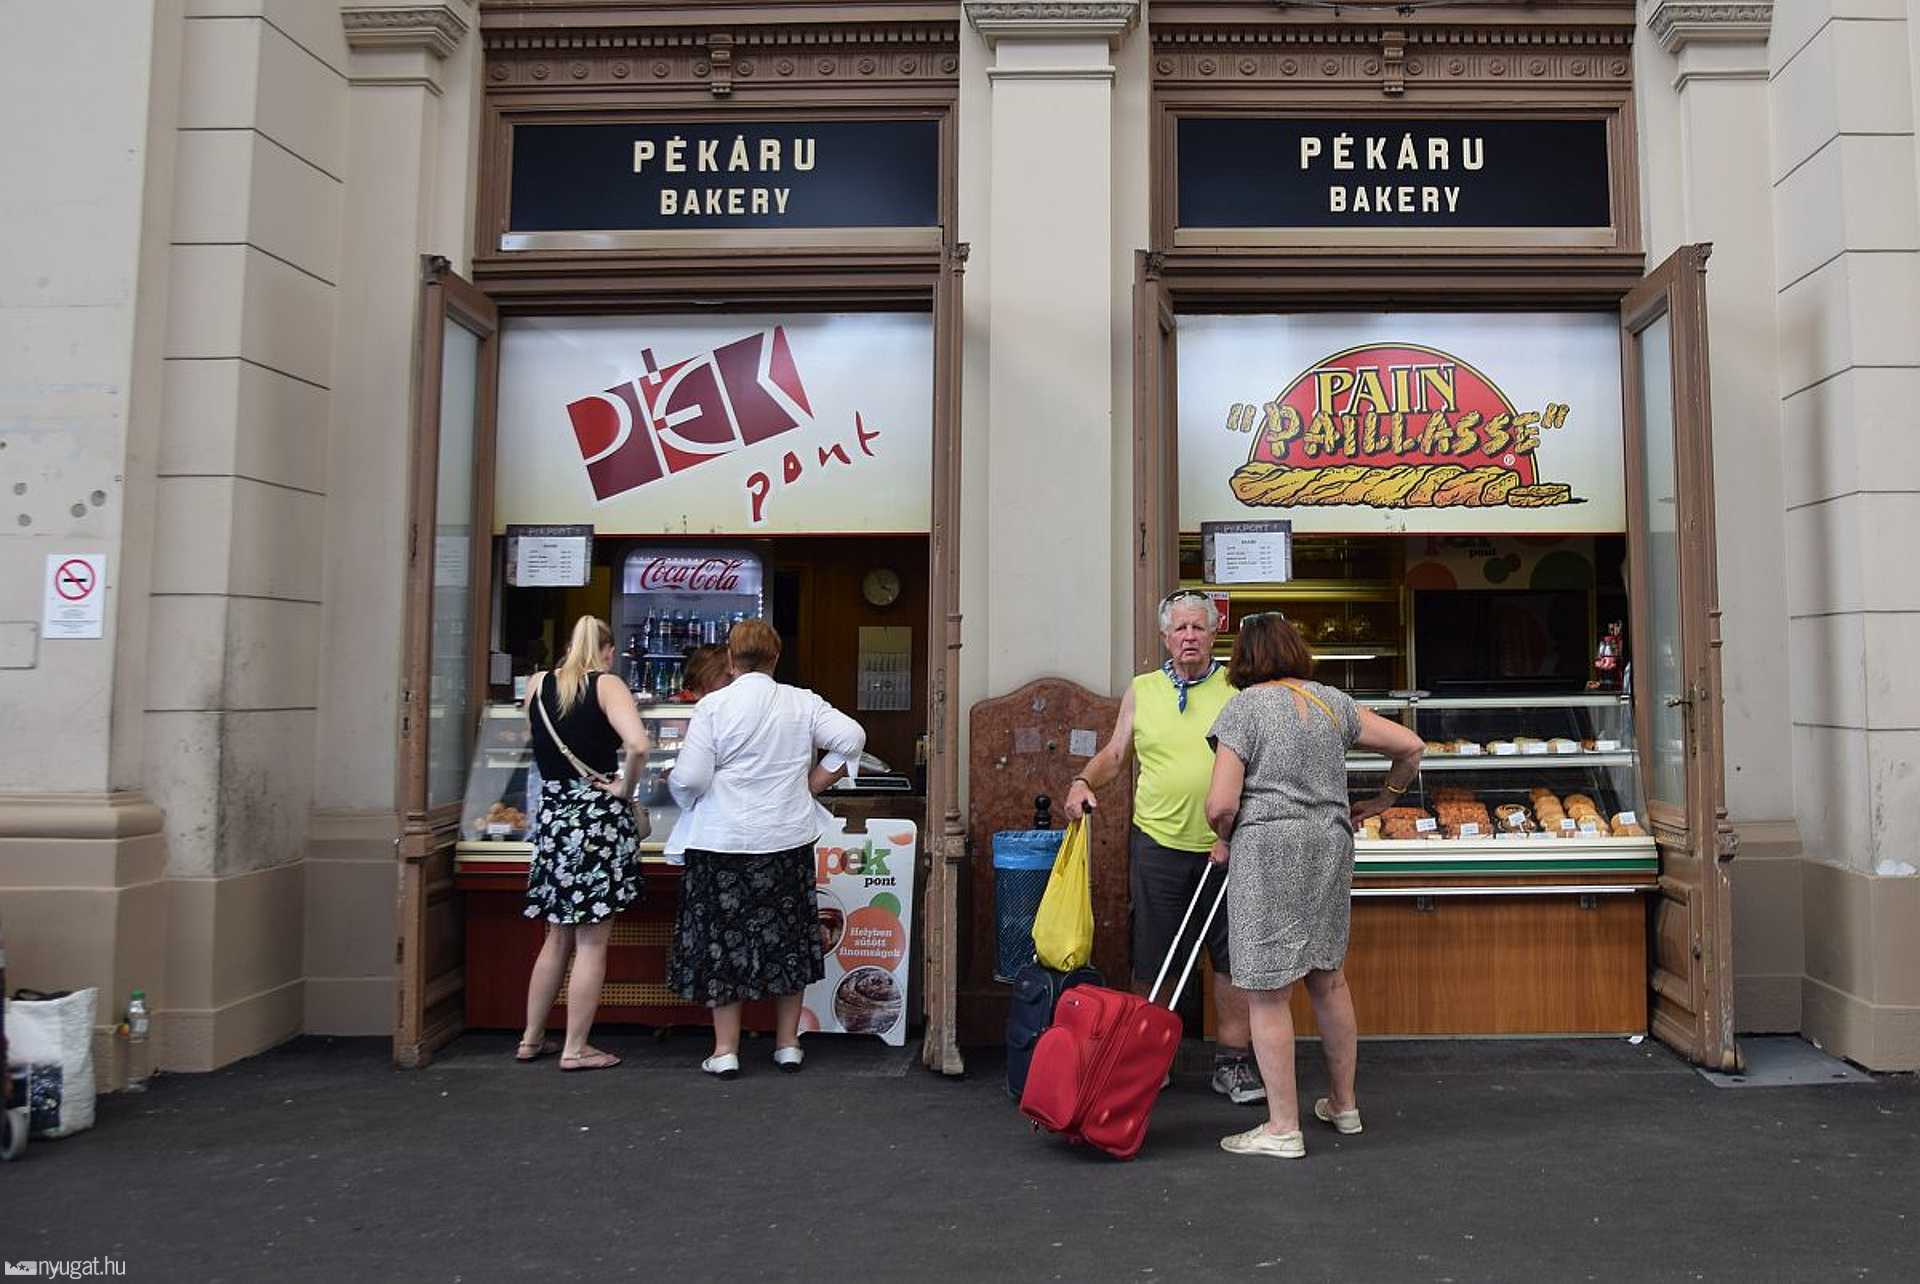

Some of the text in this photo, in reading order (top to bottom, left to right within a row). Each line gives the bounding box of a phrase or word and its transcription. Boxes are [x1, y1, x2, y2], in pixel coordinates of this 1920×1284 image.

[633, 135, 816, 172] PÉKÁRU
[1300, 132, 1484, 170] PÉKÁRU
[660, 188, 790, 215] BAKERY
[1330, 186, 1460, 212] BAKERY
[1313, 362, 1456, 417] PAIN
[746, 410, 880, 522] pont
[640, 557, 743, 591] Coca-Cola
[864, 876, 897, 888] pont
